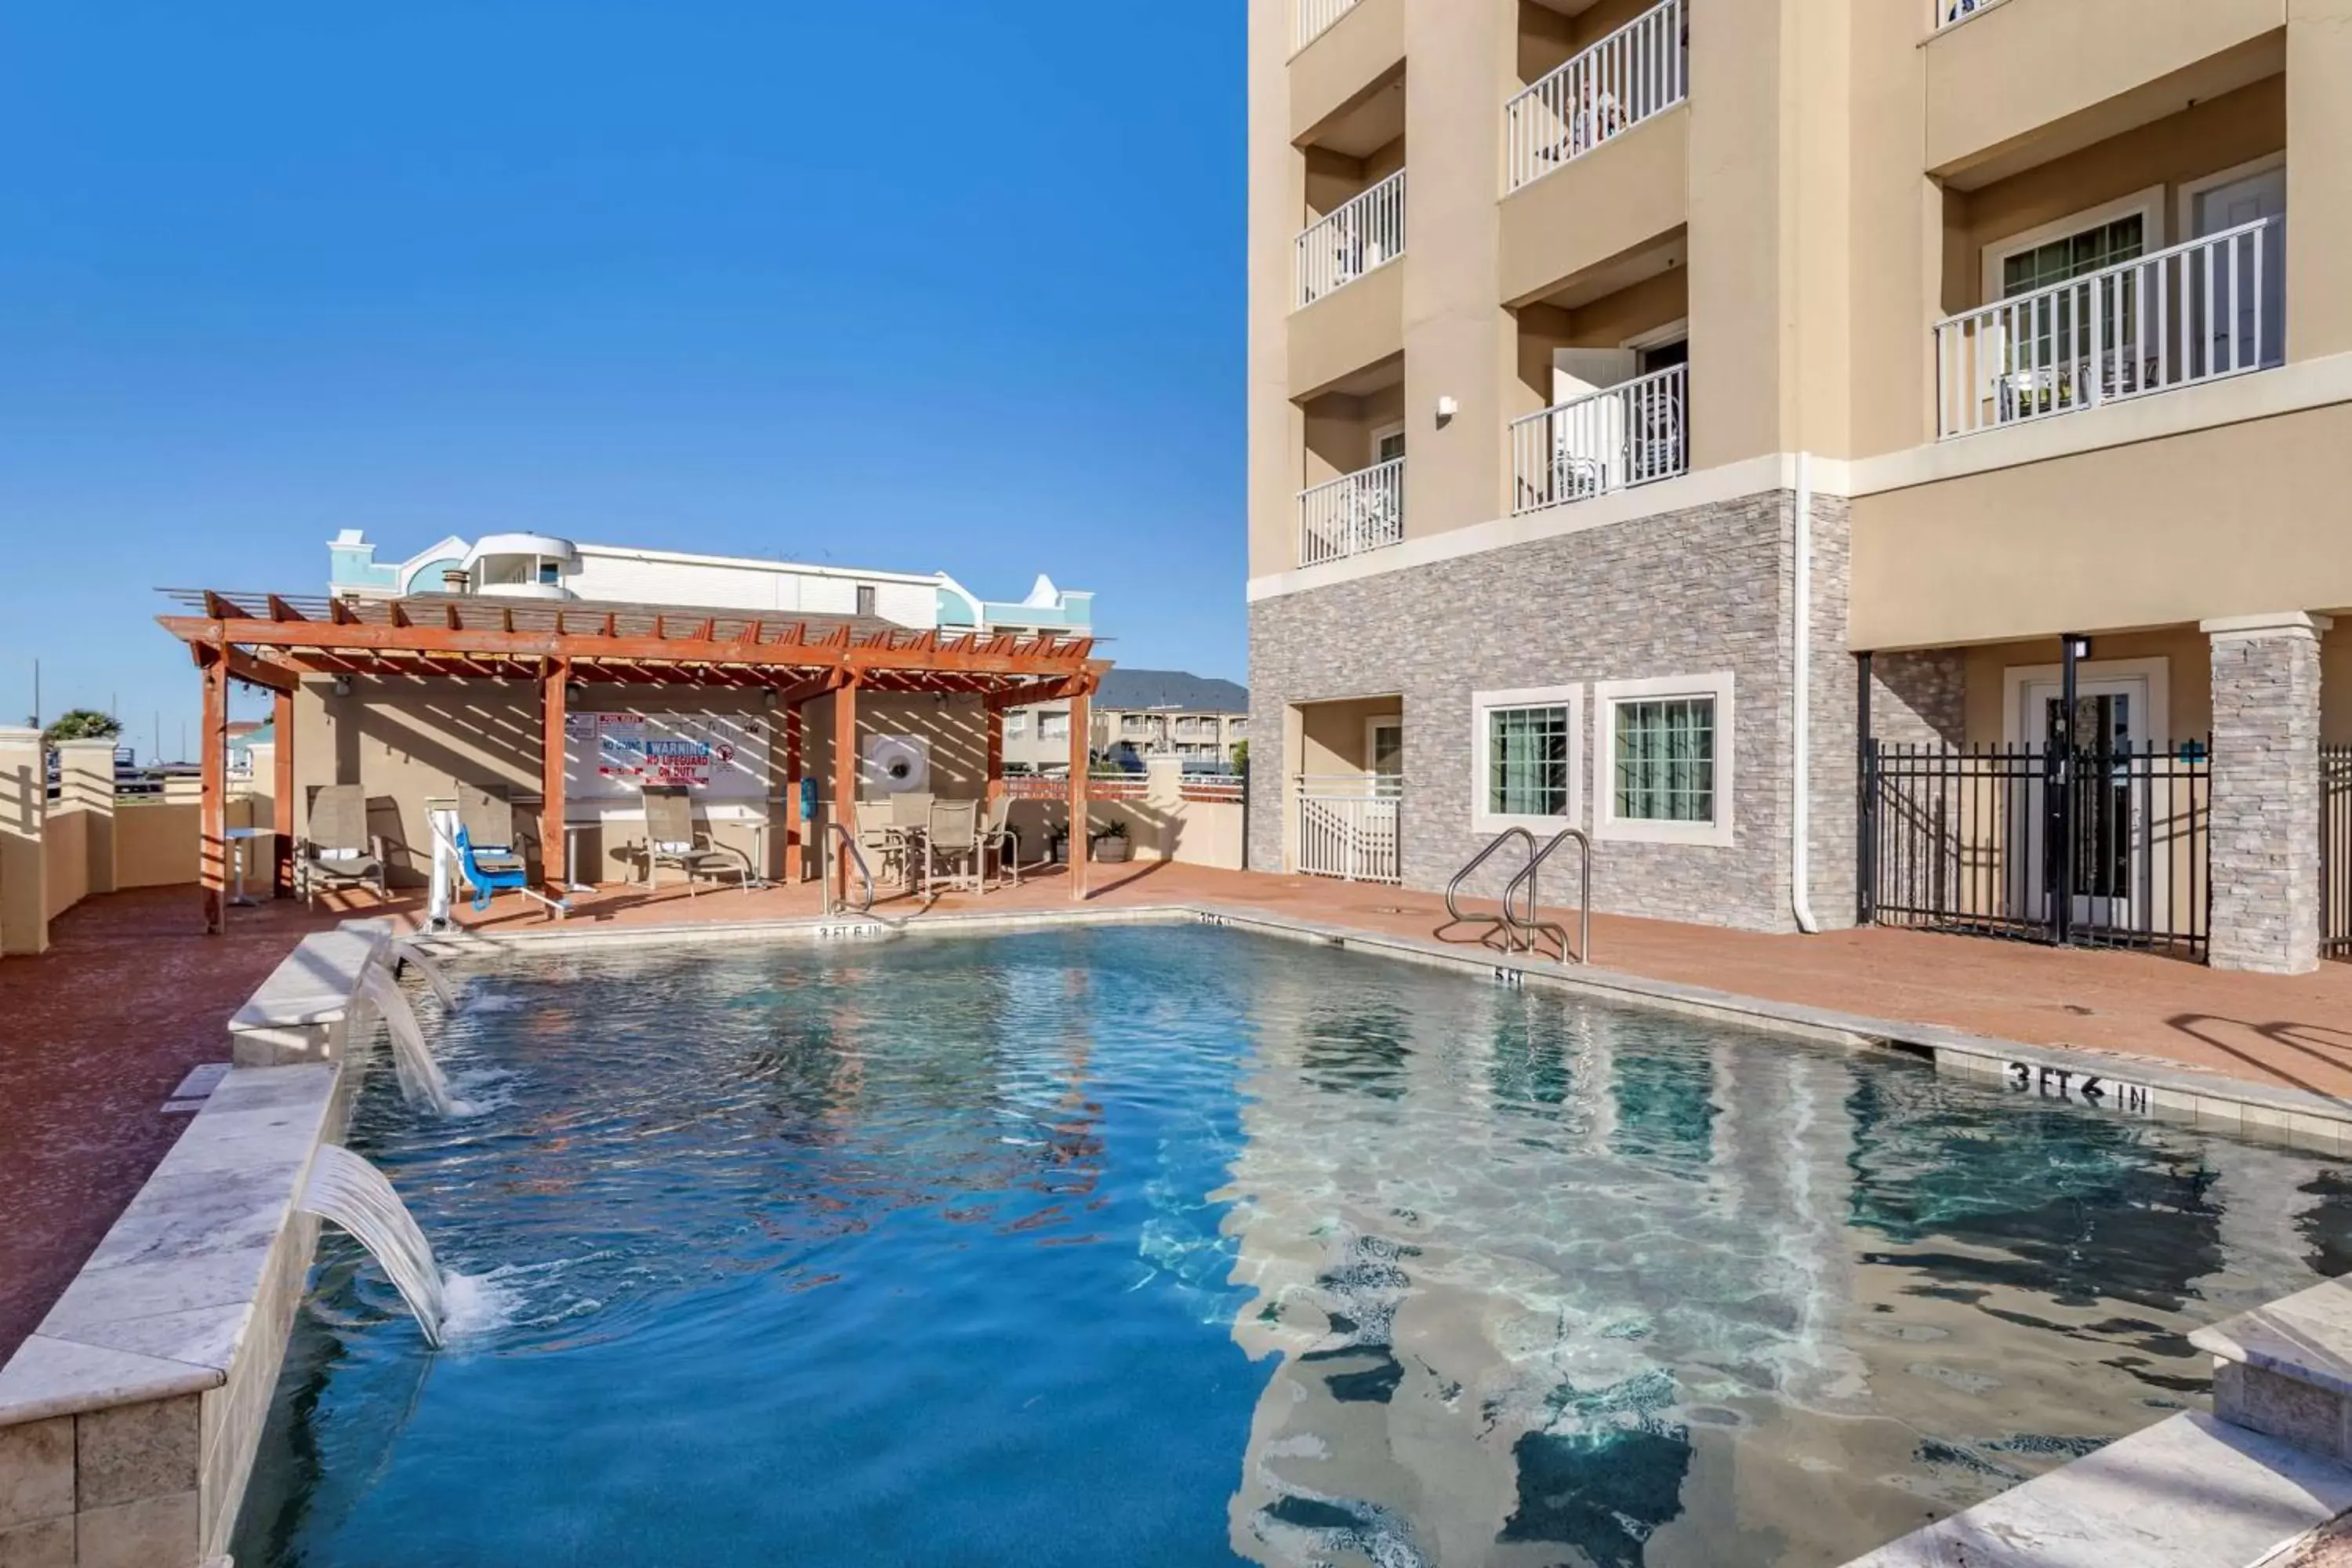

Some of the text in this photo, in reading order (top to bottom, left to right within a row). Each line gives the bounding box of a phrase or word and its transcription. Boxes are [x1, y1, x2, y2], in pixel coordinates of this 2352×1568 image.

[647, 755, 659, 765] NO
[663, 755, 708, 765] LIFEGUARD
[659, 767, 696, 776] ON DUTY
[833, 927, 848, 938] FT
[2009, 1062, 2147, 1105] 3 FT 6 IN
